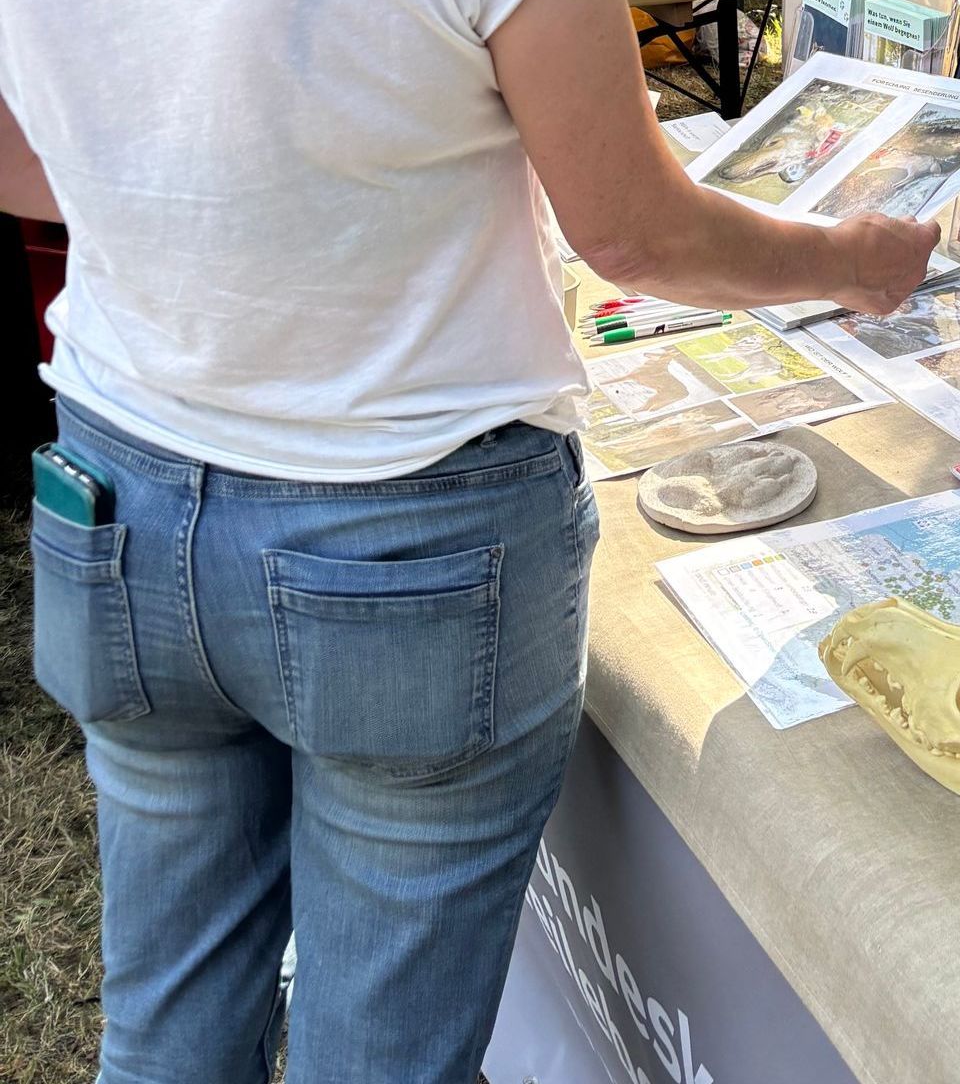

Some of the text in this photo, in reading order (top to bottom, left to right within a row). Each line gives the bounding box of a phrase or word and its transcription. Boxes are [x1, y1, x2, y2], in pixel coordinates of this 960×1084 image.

[867, 8, 877, 17] Was
[889, 16, 902, 24] wenn
[903, 18, 911, 28] Sie
[867, 19, 882, 28] einem
[883, 22, 895, 33] Wolf
[872, 78, 959, 100] FORSCHUNG BESENDERUNG
